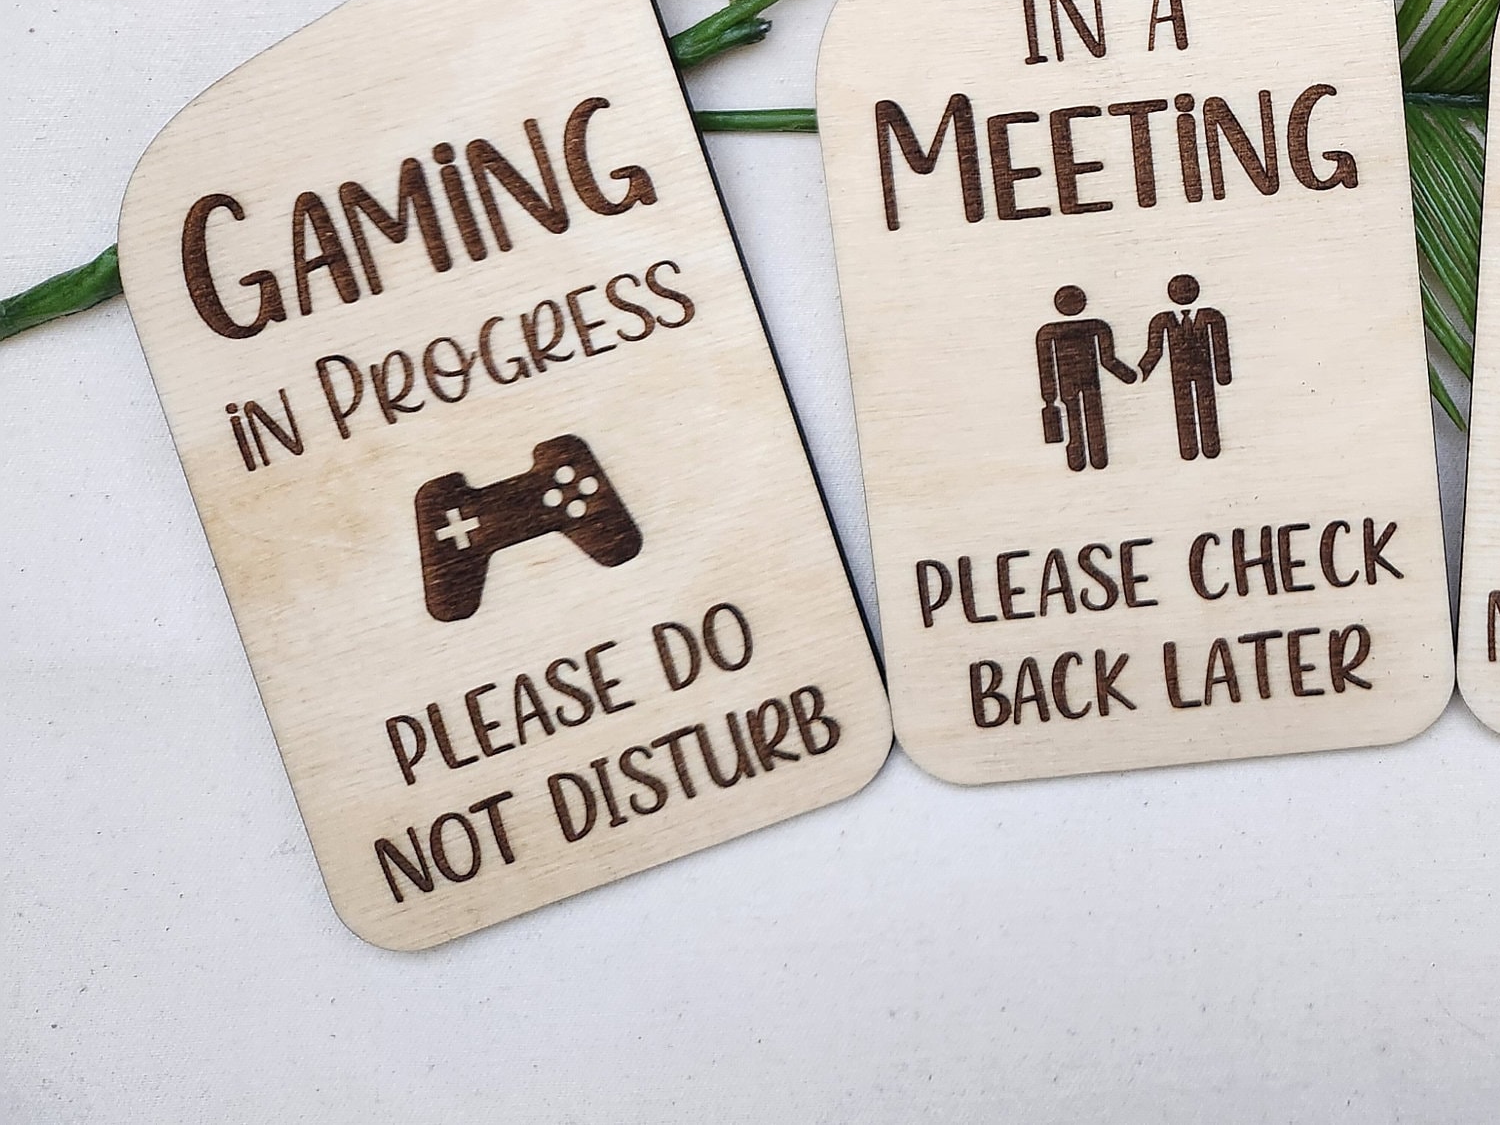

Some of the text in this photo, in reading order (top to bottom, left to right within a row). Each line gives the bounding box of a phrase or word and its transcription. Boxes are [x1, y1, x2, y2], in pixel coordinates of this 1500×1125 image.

[315, 260, 696, 440] PROGRESS
[915, 517, 1405, 629] PLEASE CHECK
[385, 602, 754, 787] PLEASE DO
[969, 623, 1373, 729] BACK LATER
[373, 685, 842, 904] NOT DISTURB
